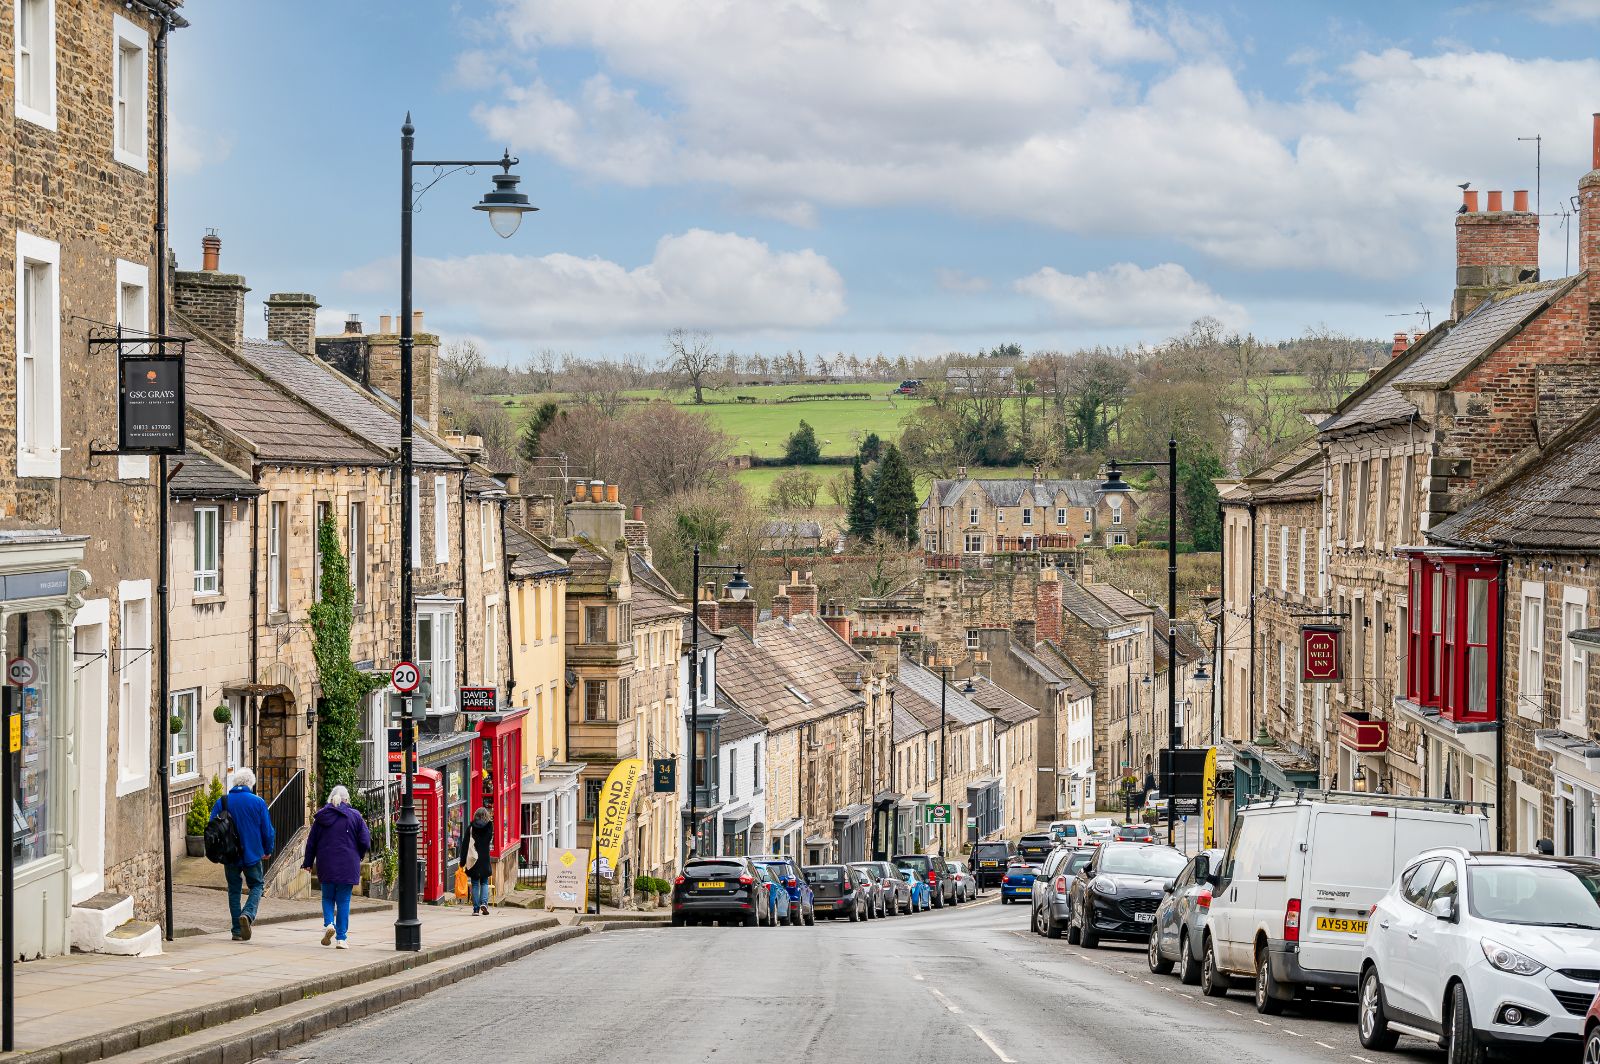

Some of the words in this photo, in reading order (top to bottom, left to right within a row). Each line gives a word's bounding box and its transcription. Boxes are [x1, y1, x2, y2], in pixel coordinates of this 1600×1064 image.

[396, 671, 416, 682] 20
[463, 691, 488, 699] DAVID
[659, 764, 670, 773] 34
[610, 833, 620, 848] THE
[615, 801, 628, 832] BUTTER
[624, 765, 636, 798] MARKET
[600, 780, 624, 848] BEYOND
[1316, 890, 1350, 898] TRANSIT
[1321, 918, 1348, 930] AY59
